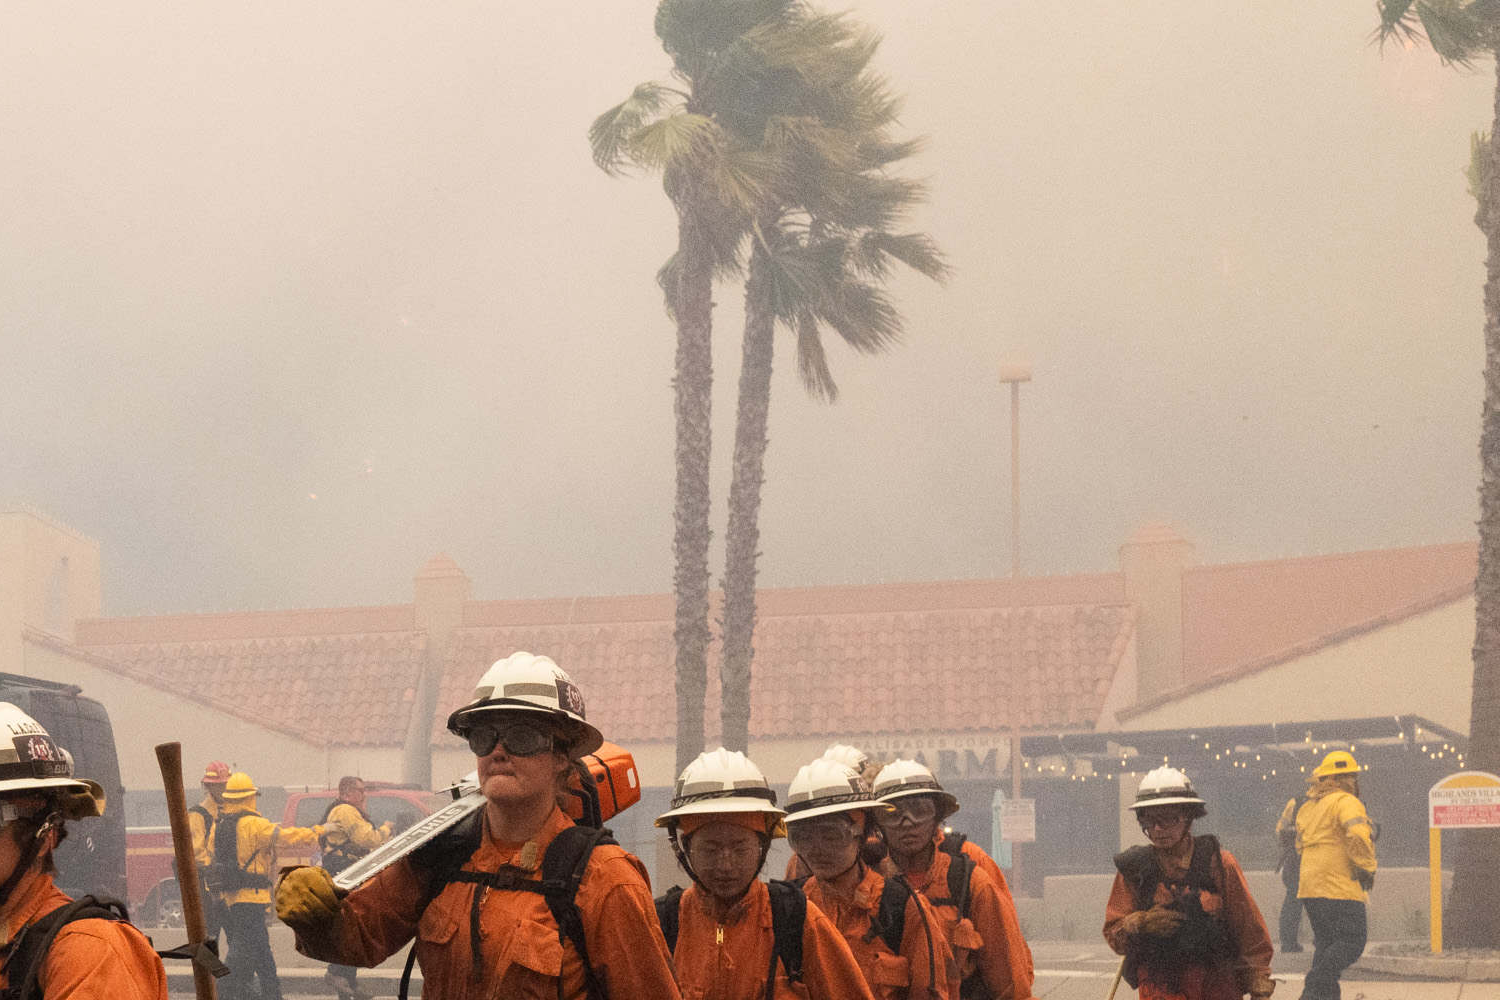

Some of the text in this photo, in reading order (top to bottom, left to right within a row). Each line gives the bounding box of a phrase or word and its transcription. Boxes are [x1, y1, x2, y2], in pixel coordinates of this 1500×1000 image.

[854, 738, 947, 750] PALISADES
[34, 745, 46, 756] 13
[1431, 790, 1477, 798] HIGHLANDS
[411, 807, 463, 837] STIHL
